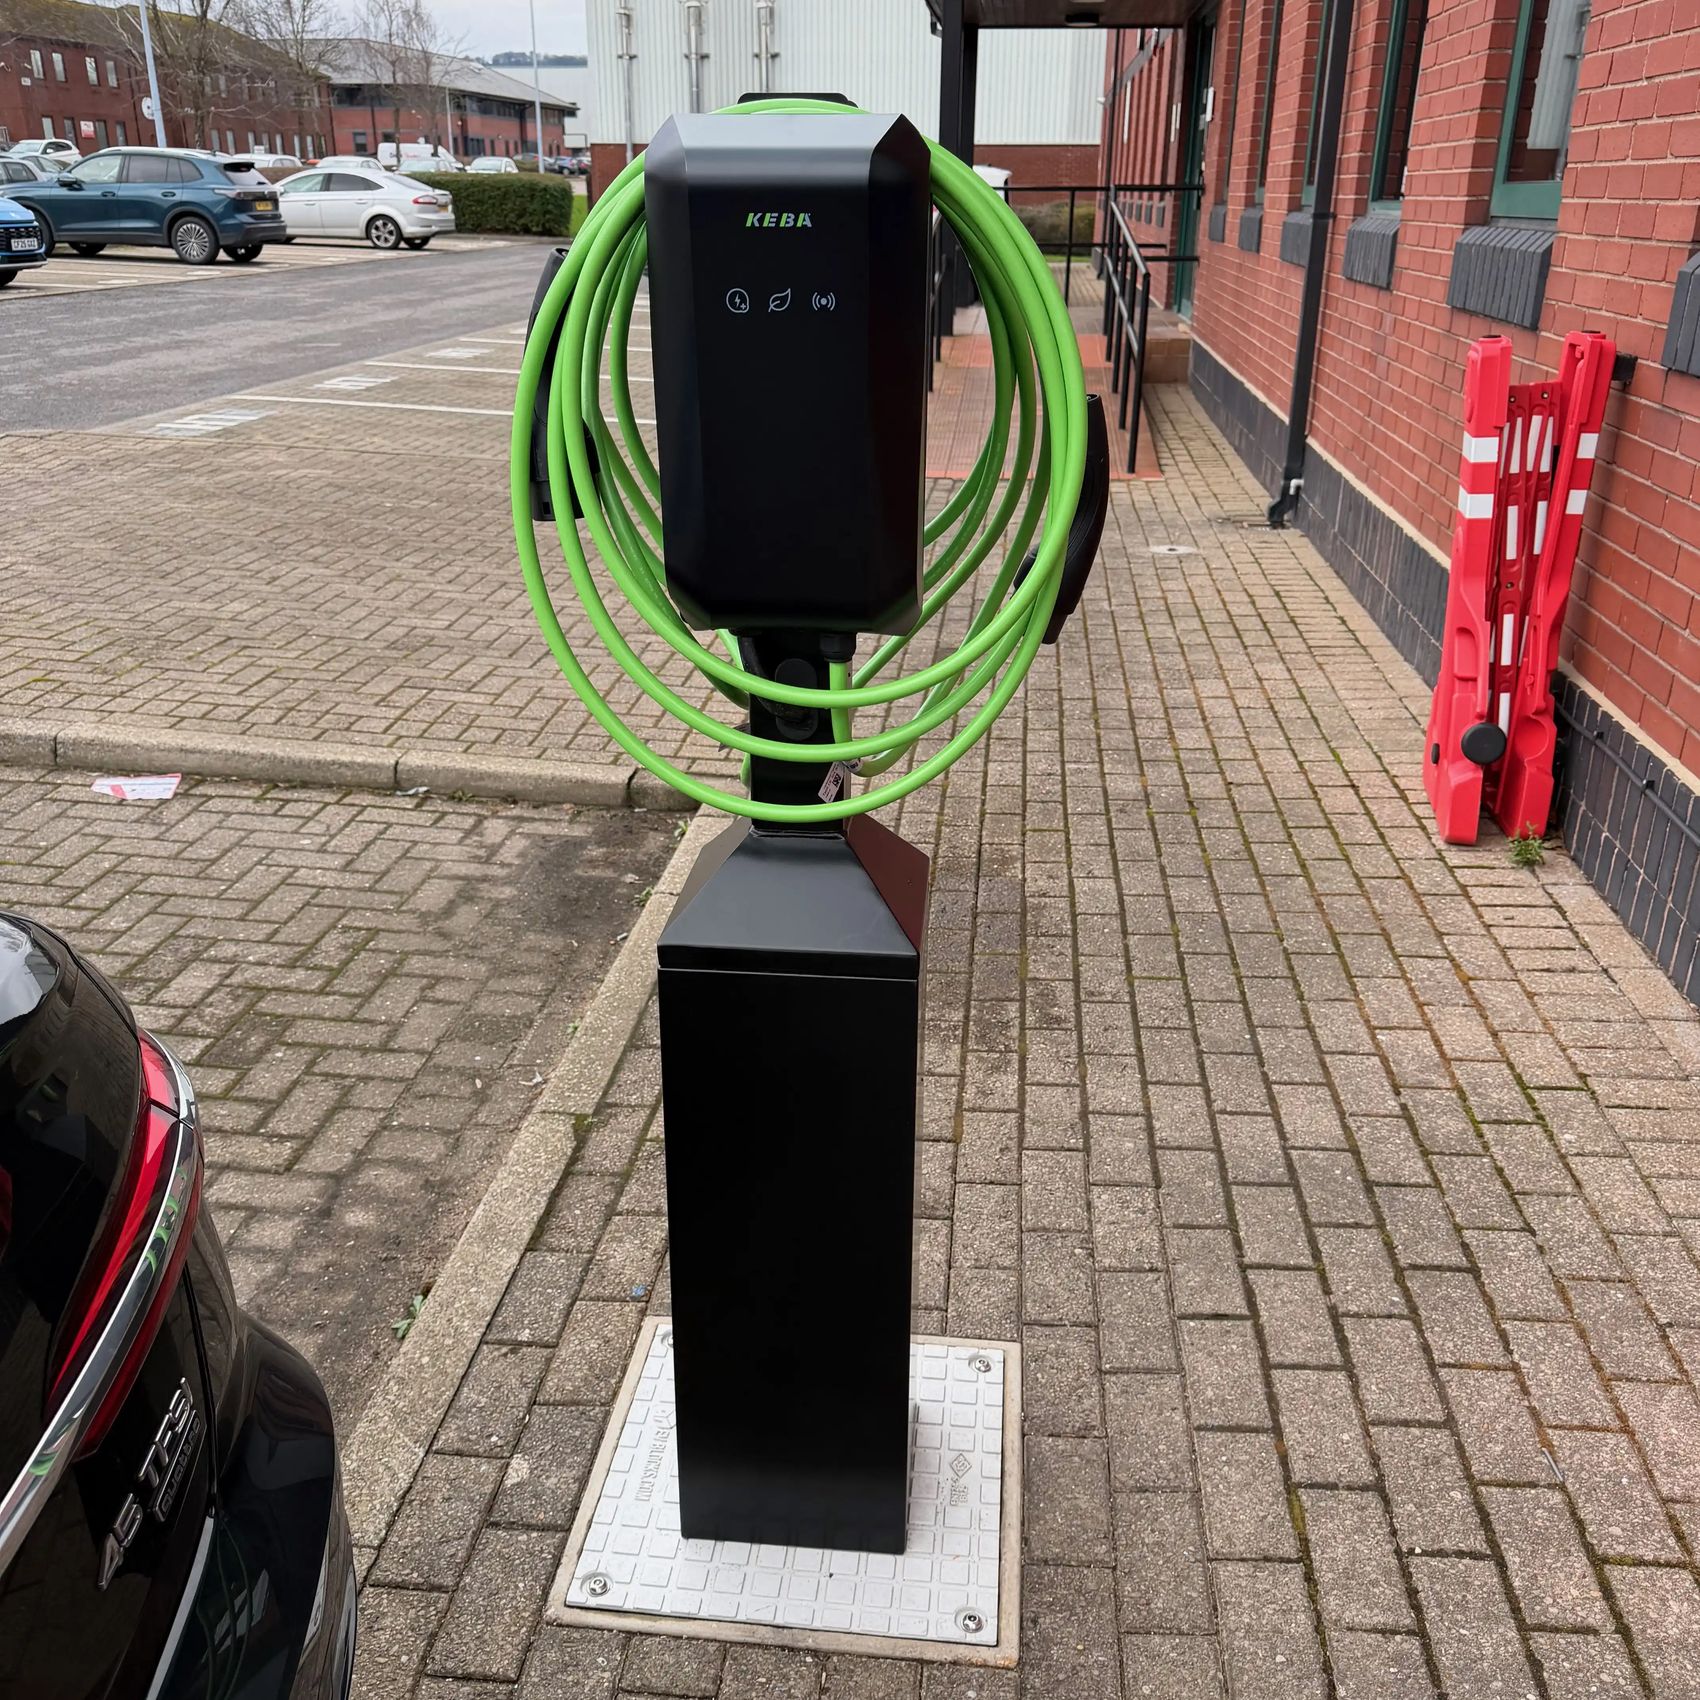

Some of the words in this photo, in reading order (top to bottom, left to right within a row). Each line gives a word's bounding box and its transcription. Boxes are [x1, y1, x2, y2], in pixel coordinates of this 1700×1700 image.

[745, 212, 813, 228] KEBA
[98, 1493, 144, 1591] 45
[137, 1376, 194, 1489] TFSI
[160, 1416, 201, 1514] quattro
